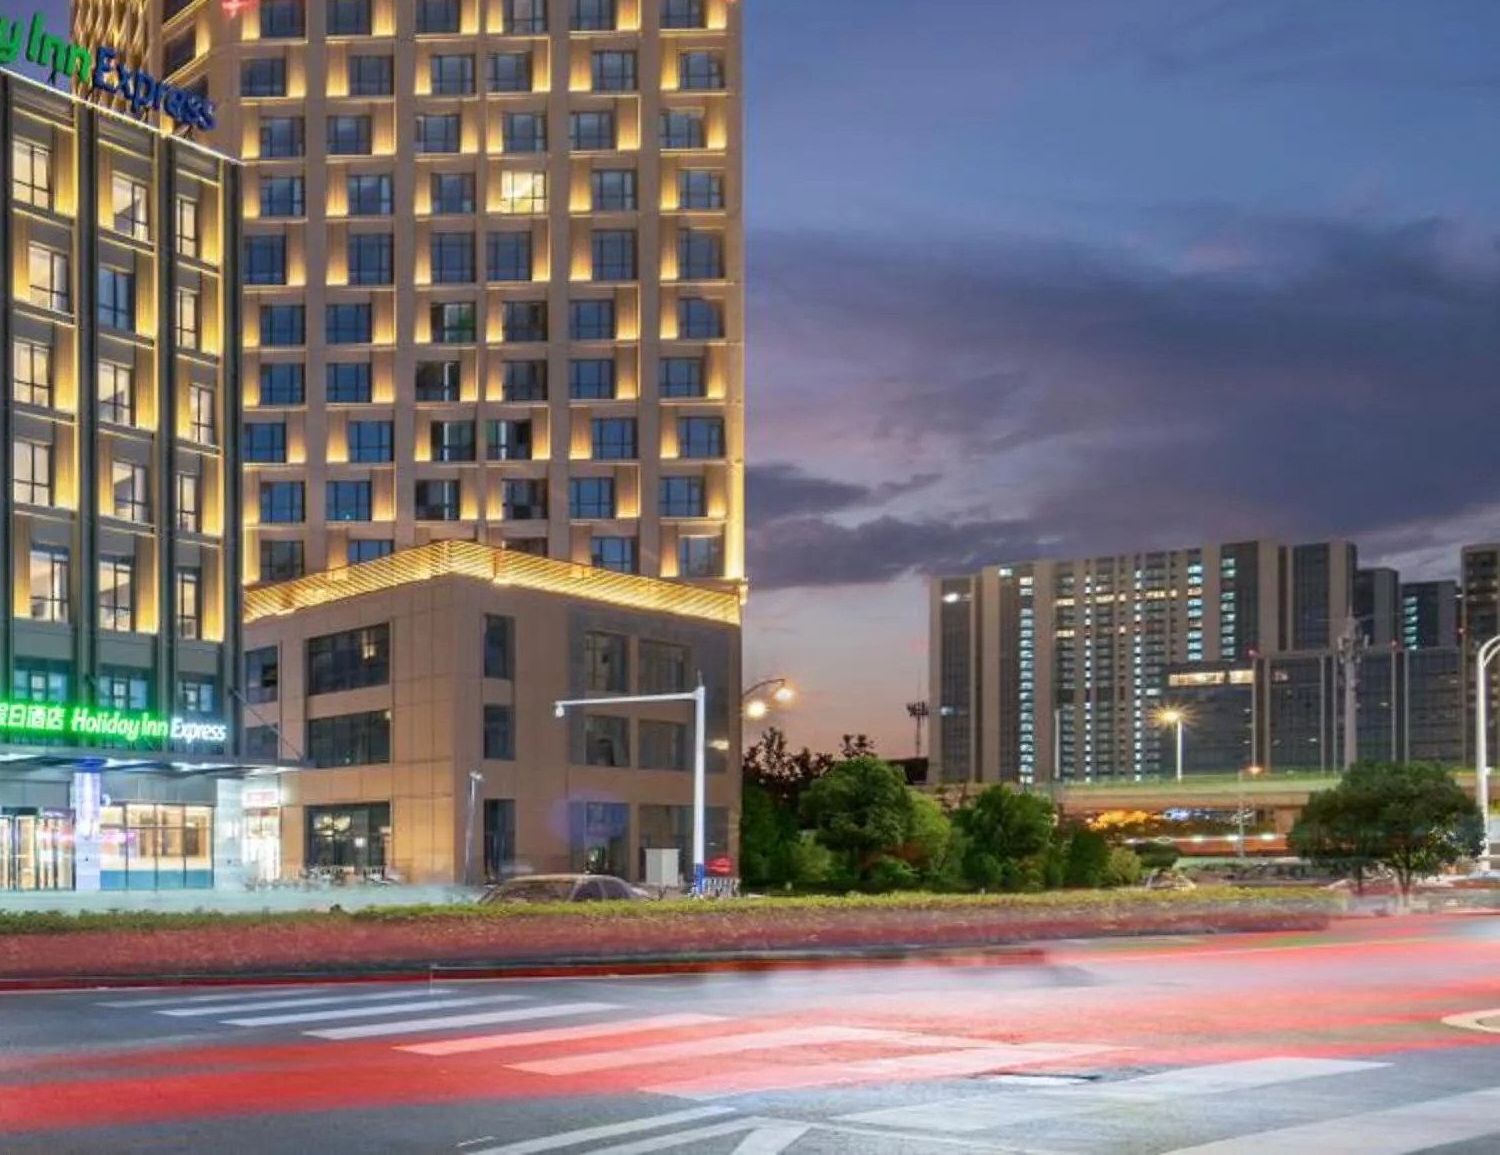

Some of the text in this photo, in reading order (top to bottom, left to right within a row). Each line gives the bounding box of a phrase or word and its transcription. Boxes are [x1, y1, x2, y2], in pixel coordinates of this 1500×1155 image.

[25, 11, 92, 83] Inn
[92, 45, 217, 131] Express
[71, 706, 227, 743] Holiday Inn Express
